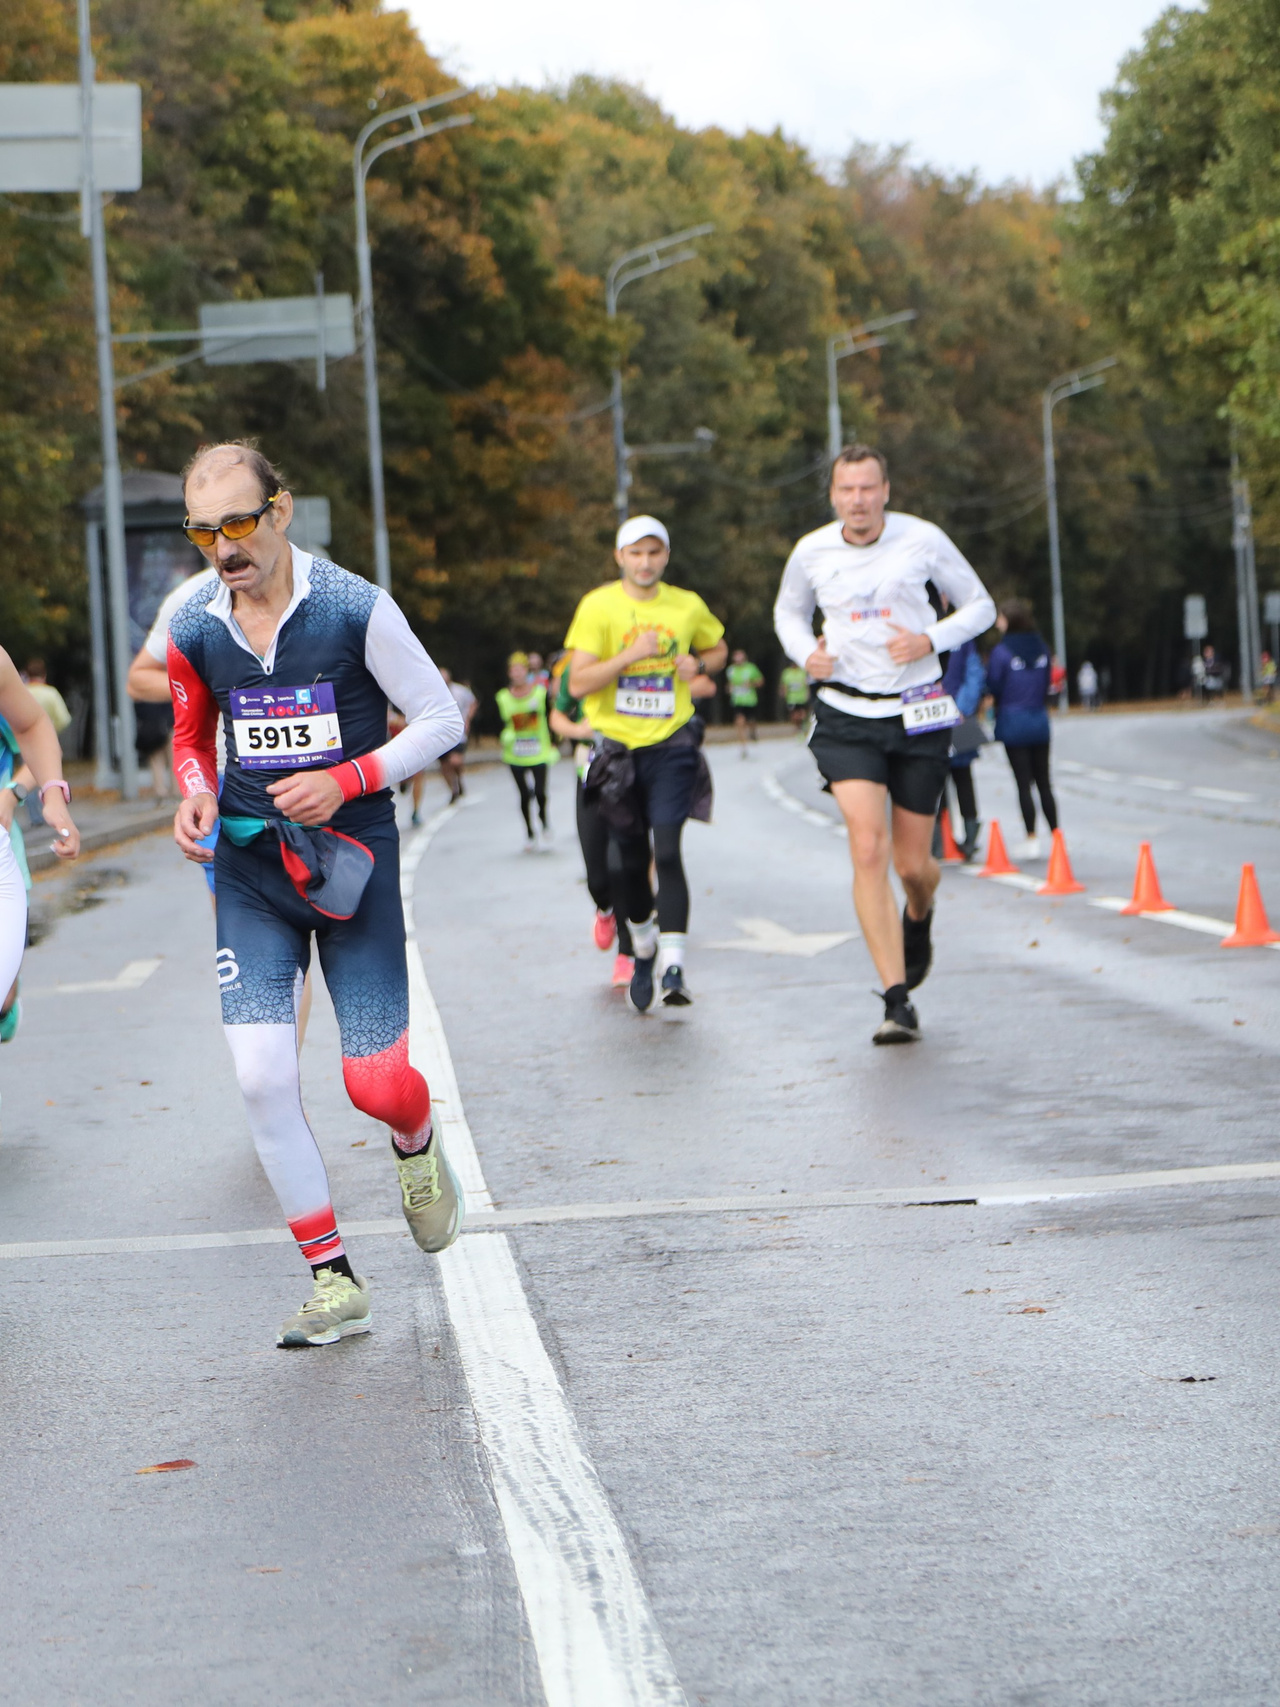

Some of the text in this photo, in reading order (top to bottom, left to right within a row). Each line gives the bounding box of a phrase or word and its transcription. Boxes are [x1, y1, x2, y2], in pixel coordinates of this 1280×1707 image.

[626, 697, 660, 709] 6151
[913, 703, 948, 722] 5187
[248, 724, 312, 749] 5913
